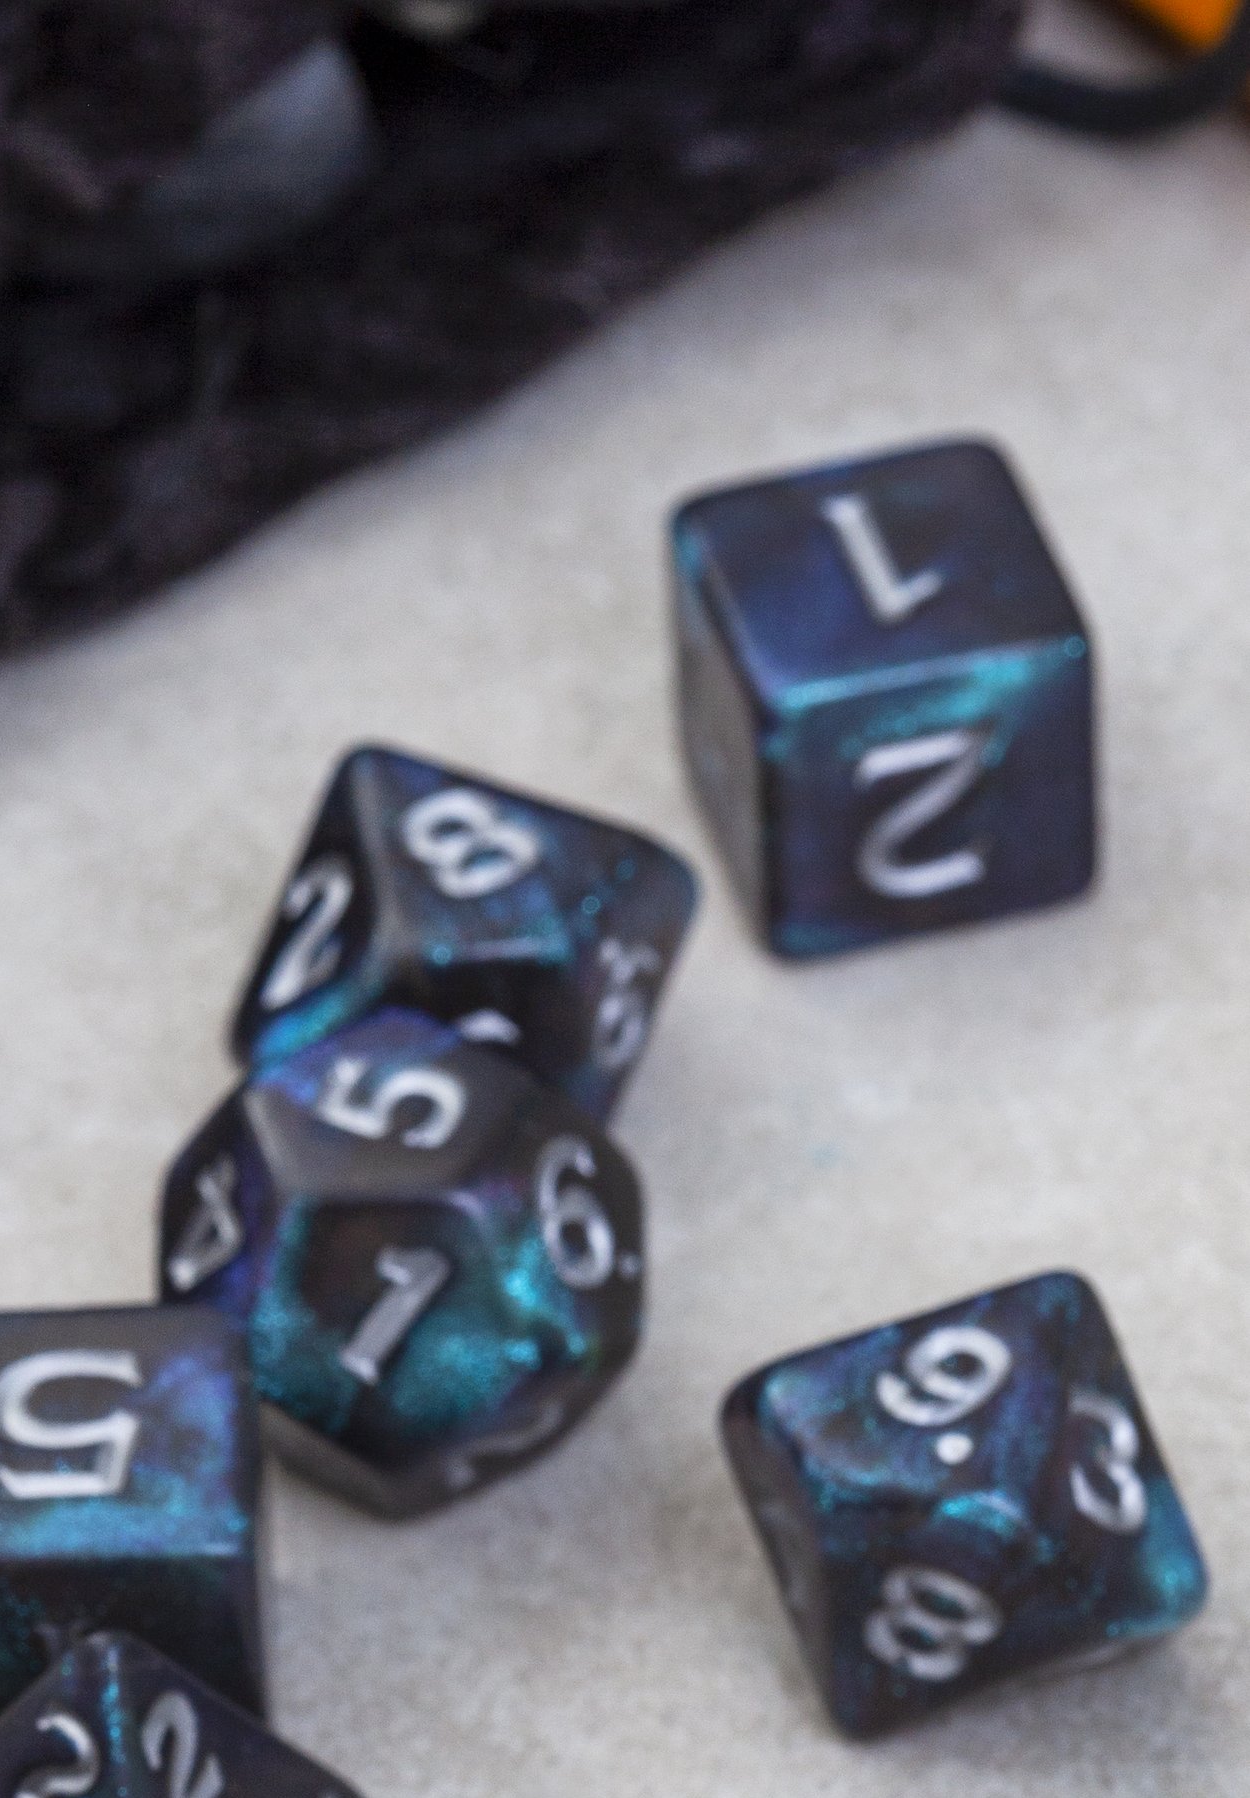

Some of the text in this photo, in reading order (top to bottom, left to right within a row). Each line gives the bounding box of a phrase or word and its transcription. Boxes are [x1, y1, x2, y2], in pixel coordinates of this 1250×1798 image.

[822, 495, 944, 624] 1
[402, 787, 542, 897] 8
[857, 728, 989, 897] 2
[261, 856, 352, 1010] 2
[317, 1058, 466, 1148] 5
[169, 1155, 245, 1291] 4
[340, 1246, 449, 1386] 1
[1069, 1384, 1147, 1536] 3
[864, 1564, 1005, 1682] 8
